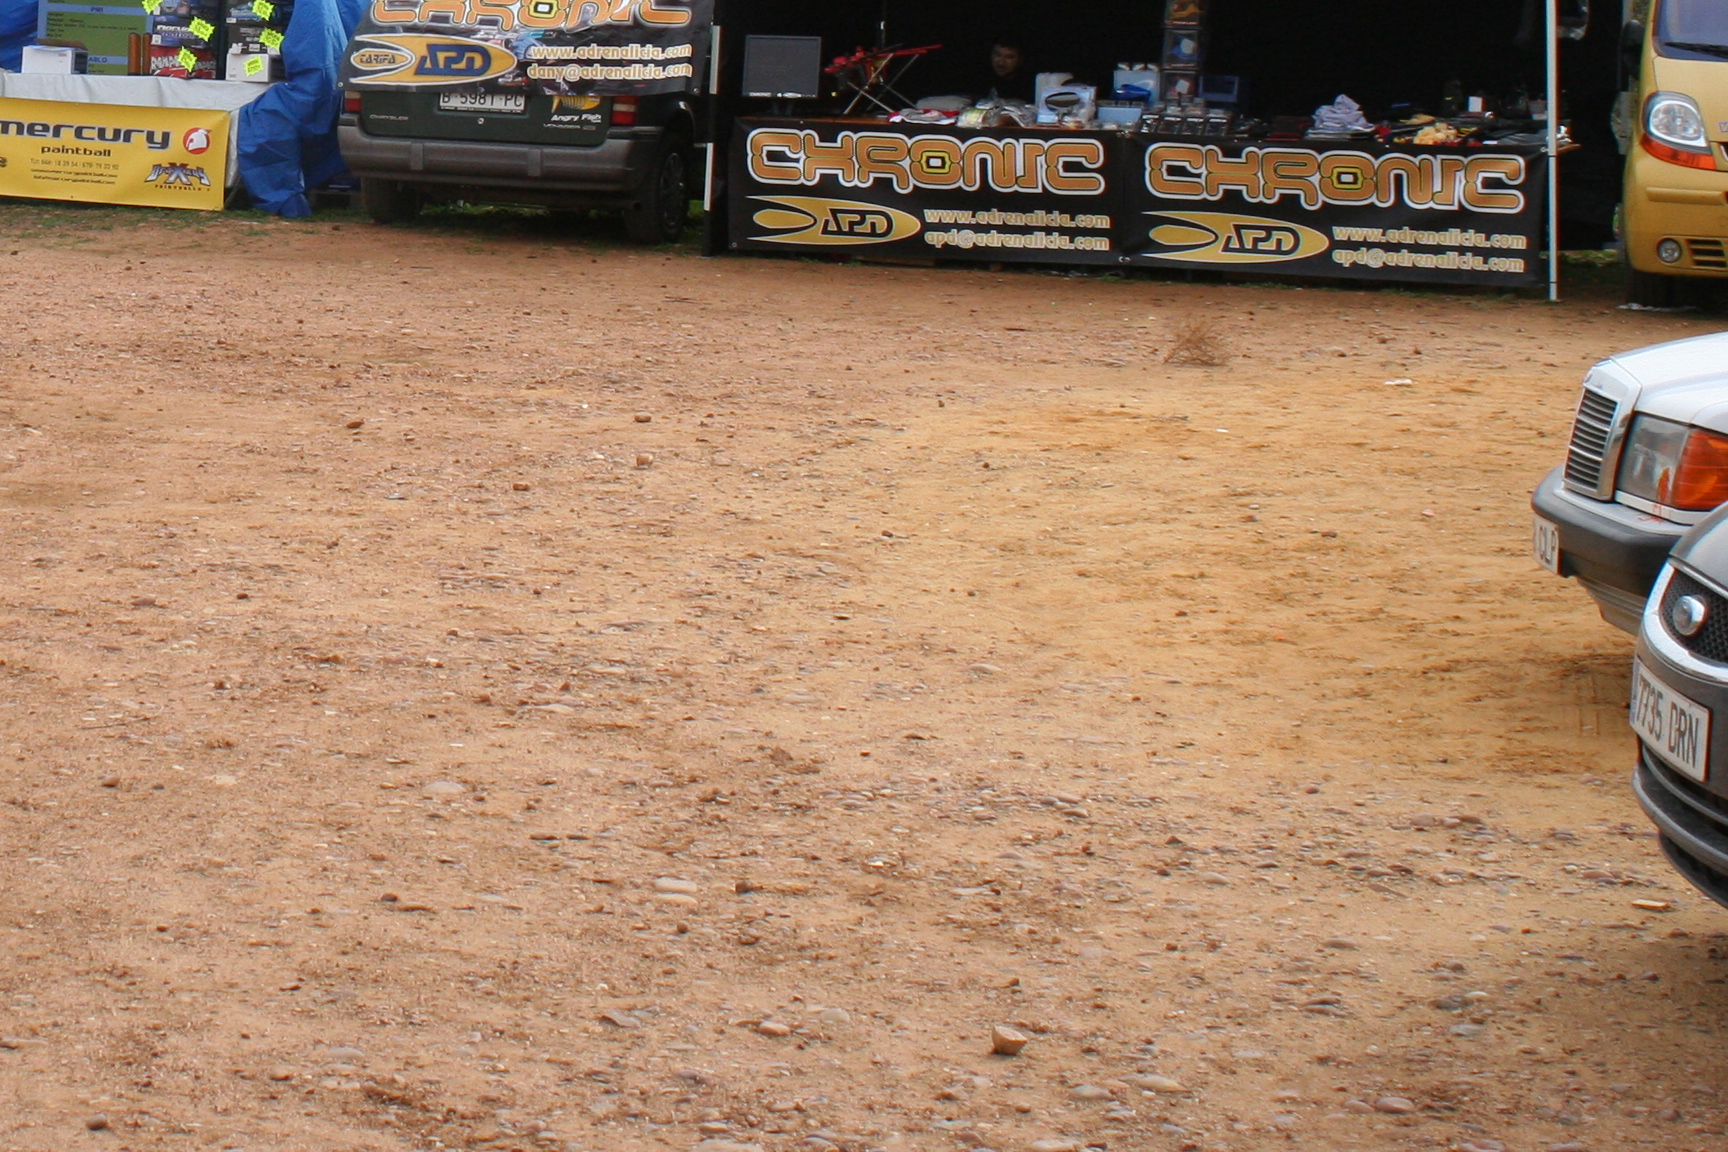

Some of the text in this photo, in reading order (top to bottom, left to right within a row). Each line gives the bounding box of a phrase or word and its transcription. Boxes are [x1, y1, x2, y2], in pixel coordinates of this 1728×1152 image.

[529, 43, 693, 60] www.adrenalicia.com
[527, 63, 693, 82] dany@adrenalicia.com
[41, 145, 111, 157] paintball
[746, 127, 1105, 195] CHRONIC
[1145, 142, 1526, 214] CHRONIC
[923, 208, 1111, 229] www.adrenalicia.com
[924, 229, 1110, 251] apd@adrenalicia.com
[1332, 226, 1527, 249] www.adrenalicia.com
[1331, 247, 1525, 273] apd@adrenalicia.com
